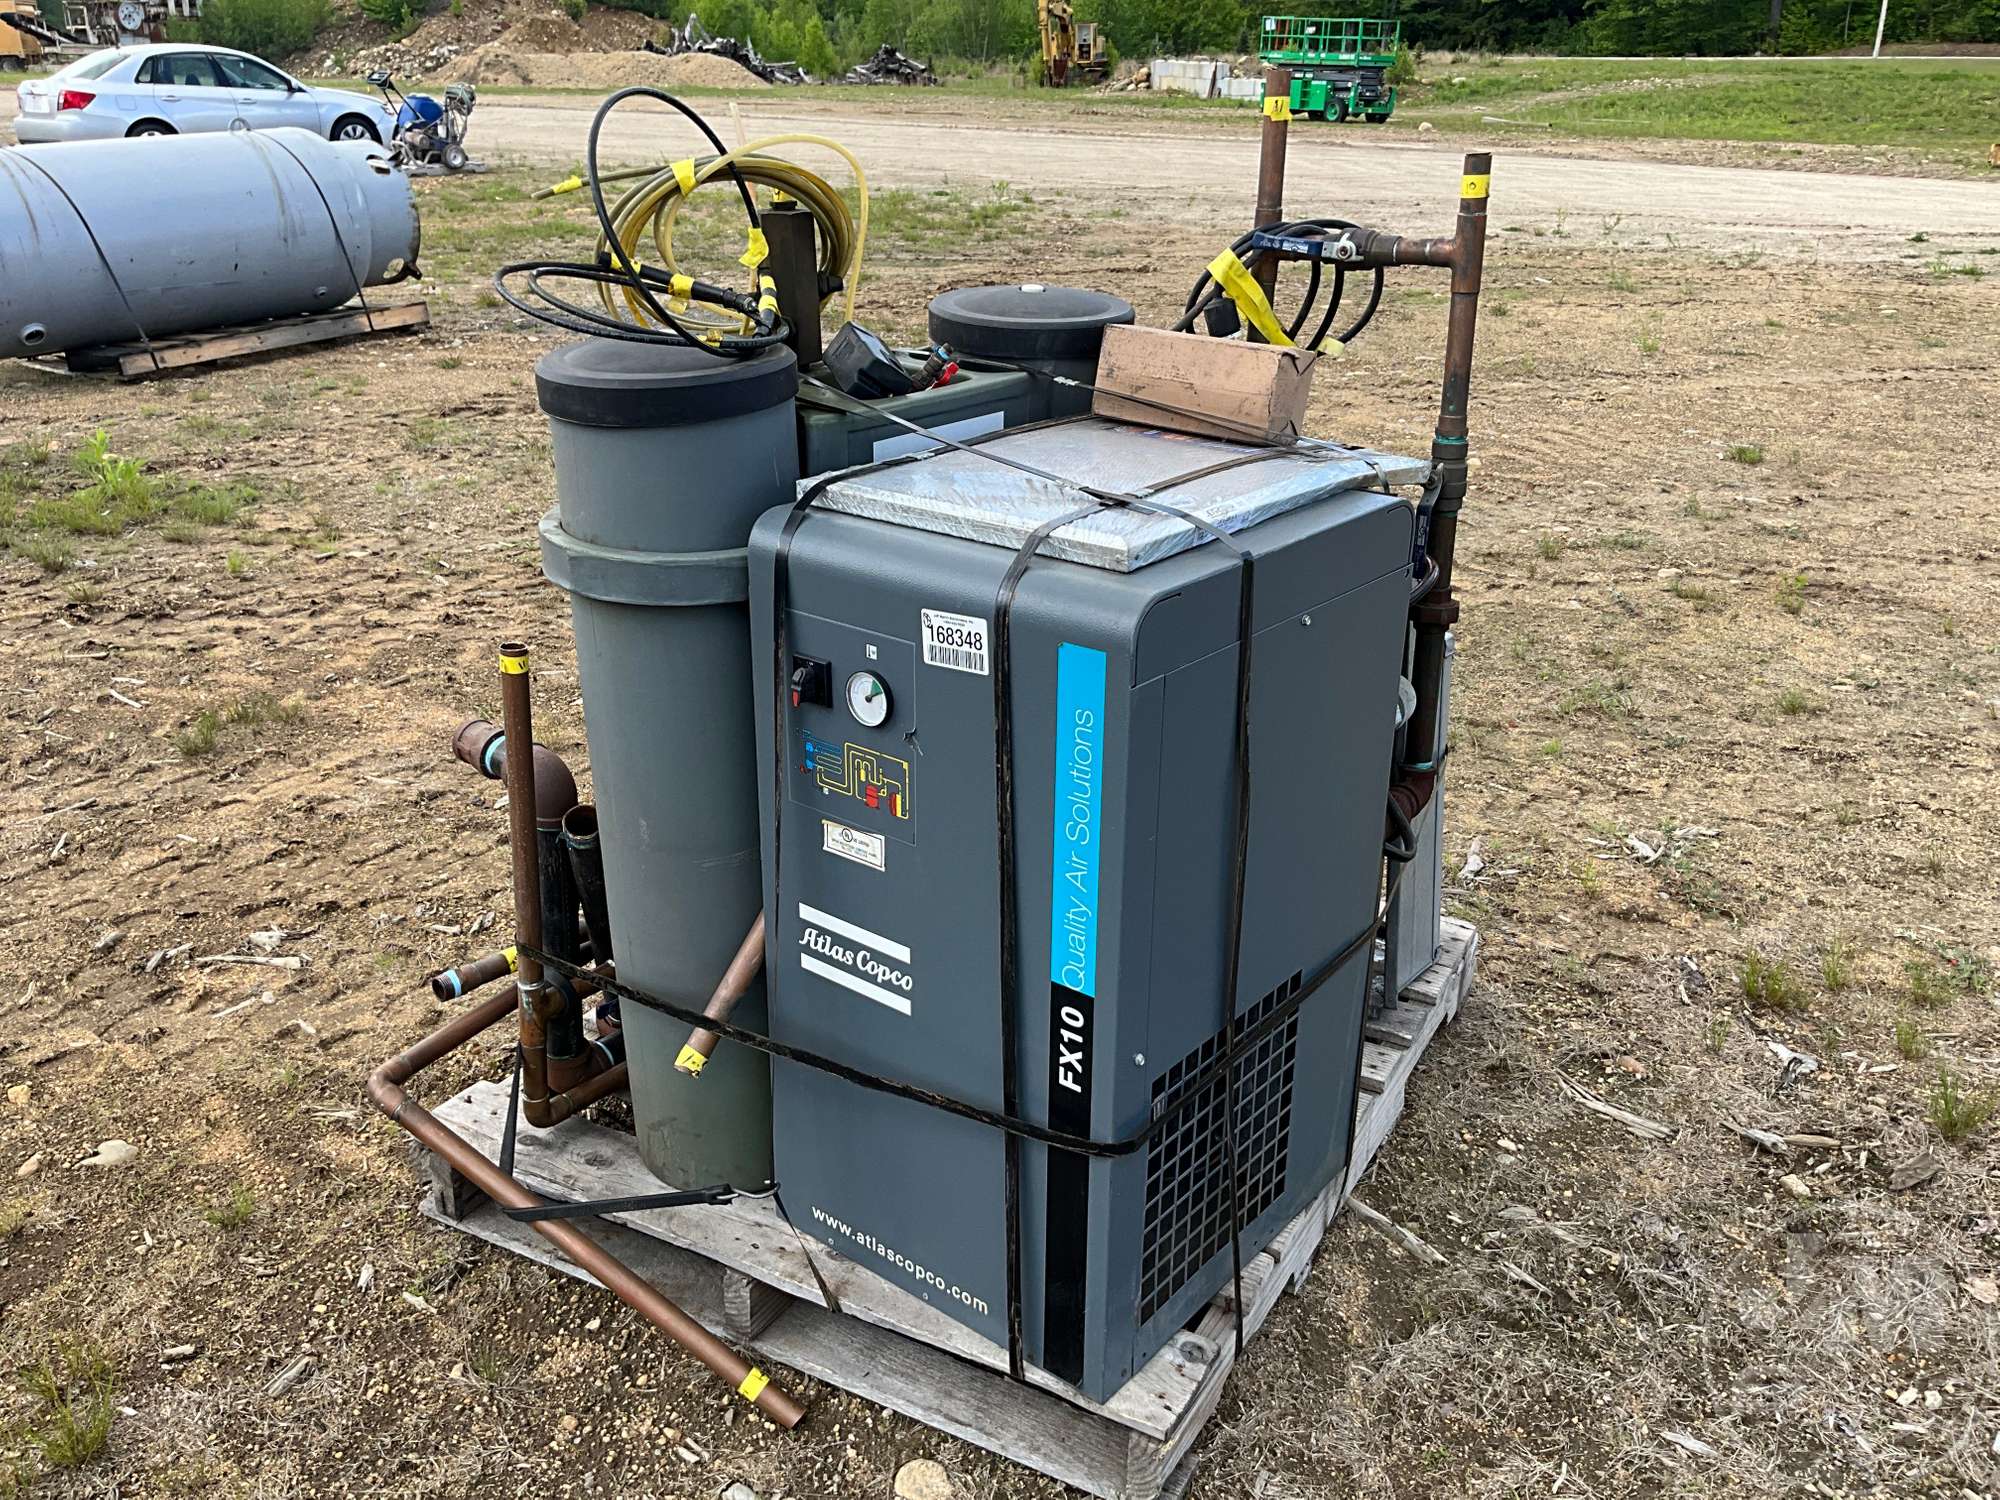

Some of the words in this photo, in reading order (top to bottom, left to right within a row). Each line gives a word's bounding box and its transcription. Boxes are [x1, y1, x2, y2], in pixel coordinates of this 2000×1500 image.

[927, 624, 983, 651] 168348
[1066, 709, 1094, 845] Solutions
[1065, 851, 1089, 893] Air
[799, 928, 854, 965] Atlas
[856, 950, 913, 991] Copco
[1062, 895, 1092, 991] Quality
[1059, 1006, 1085, 1093] FX10
[811, 1206, 989, 1316] www.atlascopco.com
